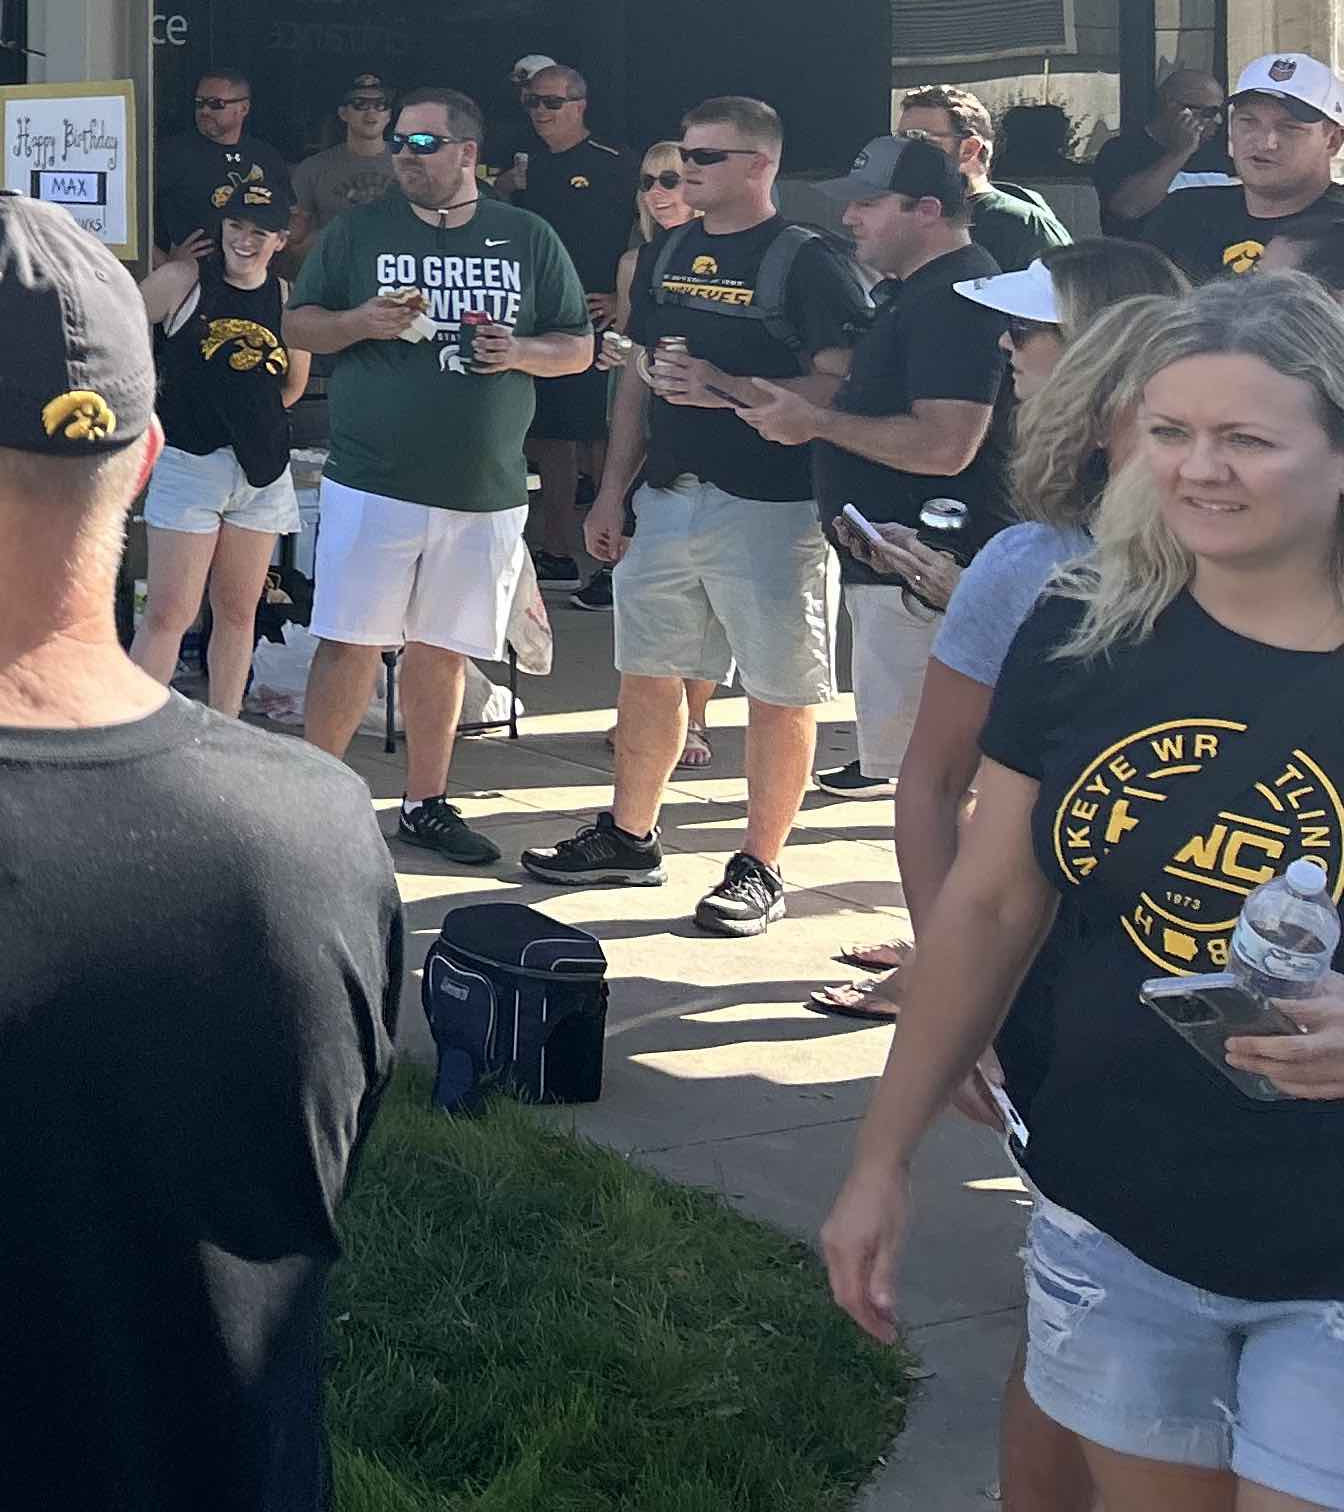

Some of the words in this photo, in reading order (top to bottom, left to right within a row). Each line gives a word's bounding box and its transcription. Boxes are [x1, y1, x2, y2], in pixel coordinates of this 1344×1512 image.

[14, 117, 56, 169] Happy
[62, 117, 118, 170] Birthday
[51, 177, 87, 197] MAX
[376, 253, 416, 284] GO
[423, 255, 521, 291] GREEN
[423, 288, 521, 325] WHITE
[1165, 890, 1202, 912] 1973
